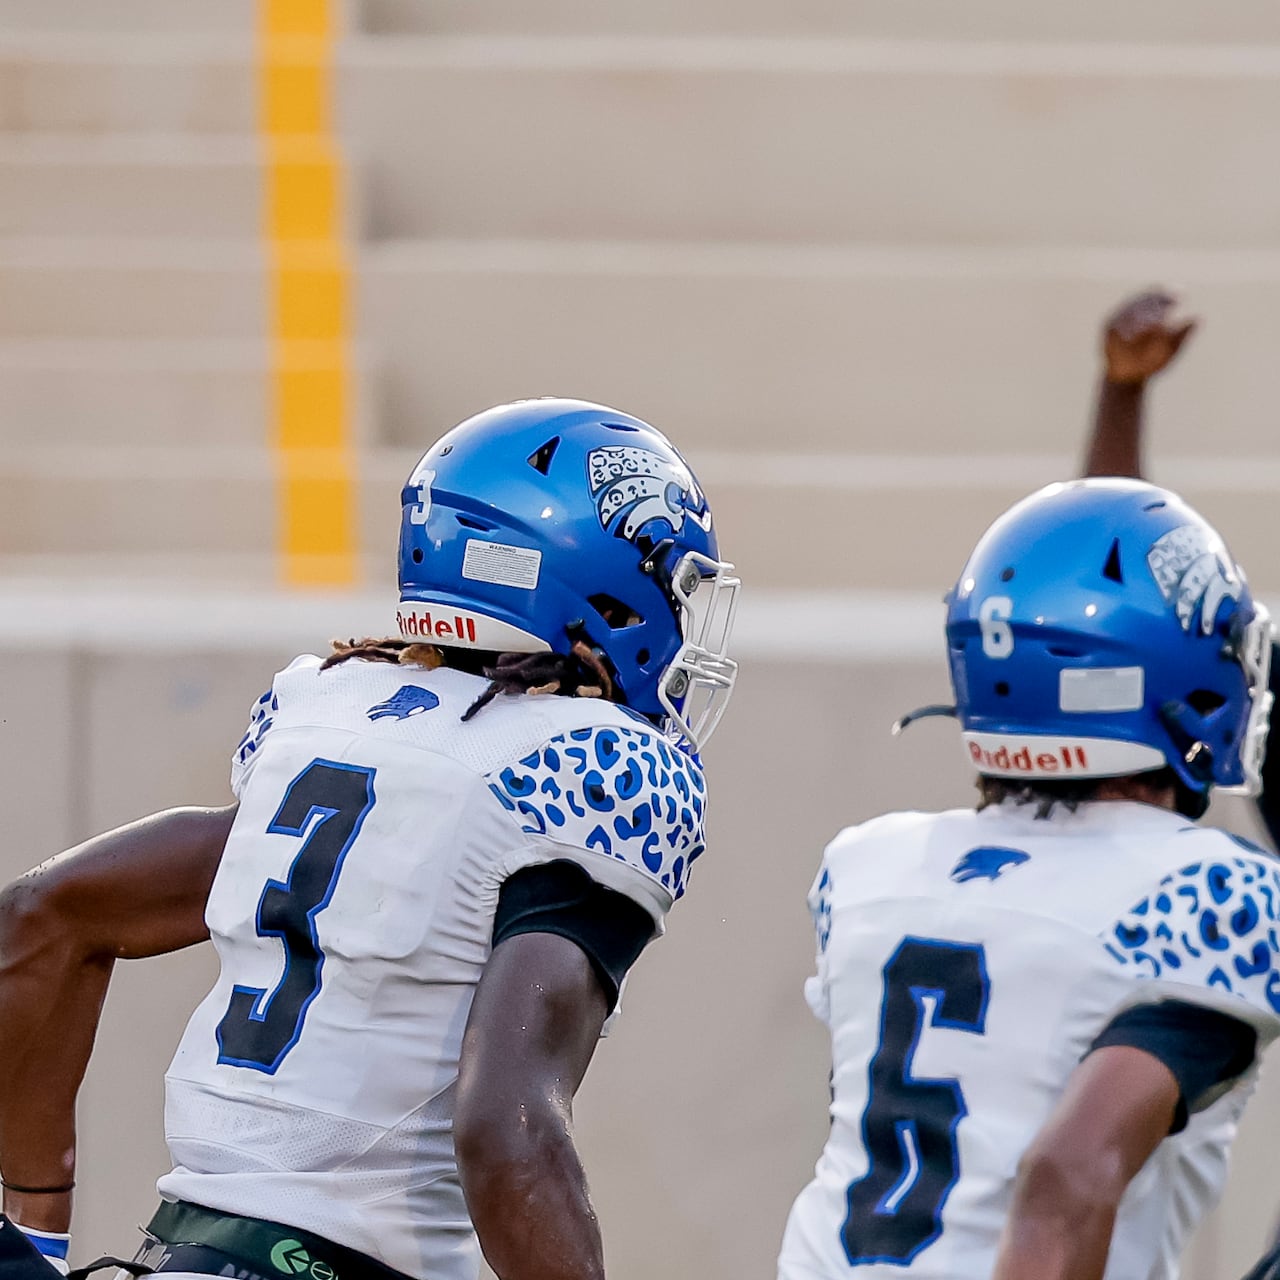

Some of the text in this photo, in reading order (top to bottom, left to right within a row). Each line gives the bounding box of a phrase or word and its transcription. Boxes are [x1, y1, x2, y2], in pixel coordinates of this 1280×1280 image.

[409, 469, 436, 525] 3
[979, 596, 1014, 659] 6
[968, 741, 1087, 771] Riddell
[216, 757, 377, 1076] 3
[839, 935, 991, 1267] 6
